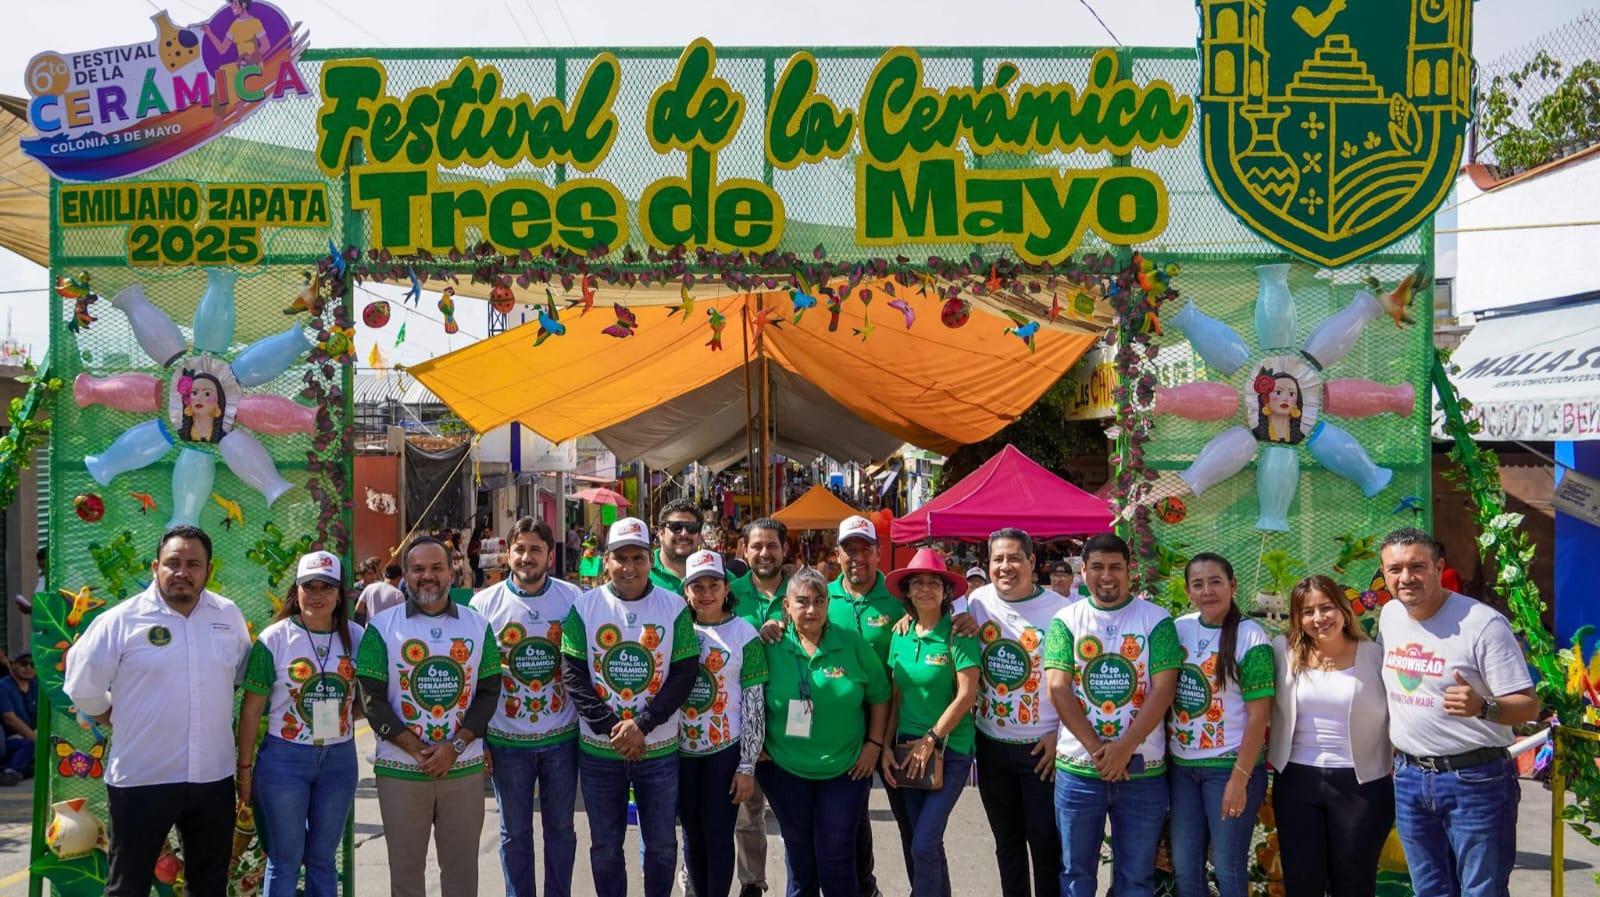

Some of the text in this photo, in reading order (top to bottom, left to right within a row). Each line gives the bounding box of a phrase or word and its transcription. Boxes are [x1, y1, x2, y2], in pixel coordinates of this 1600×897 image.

[73, 45, 156, 69] FESTIVAL
[32, 61, 68, 92] 6to
[75, 65, 124, 85] DE LA
[31, 60, 308, 132] CERÁMICA
[320, 44, 1190, 171] Festival de la Cerámica
[50, 123, 182, 154] COLONIA 3 DE MAYO
[61, 187, 327, 222] EMILIANO ZAPATA
[357, 146, 1159, 257] Tres de Mayo
[129, 225, 262, 263] 2025
[1387, 655, 1443, 674] ARROWHEAD
[1415, 695, 1435, 708] MADE
